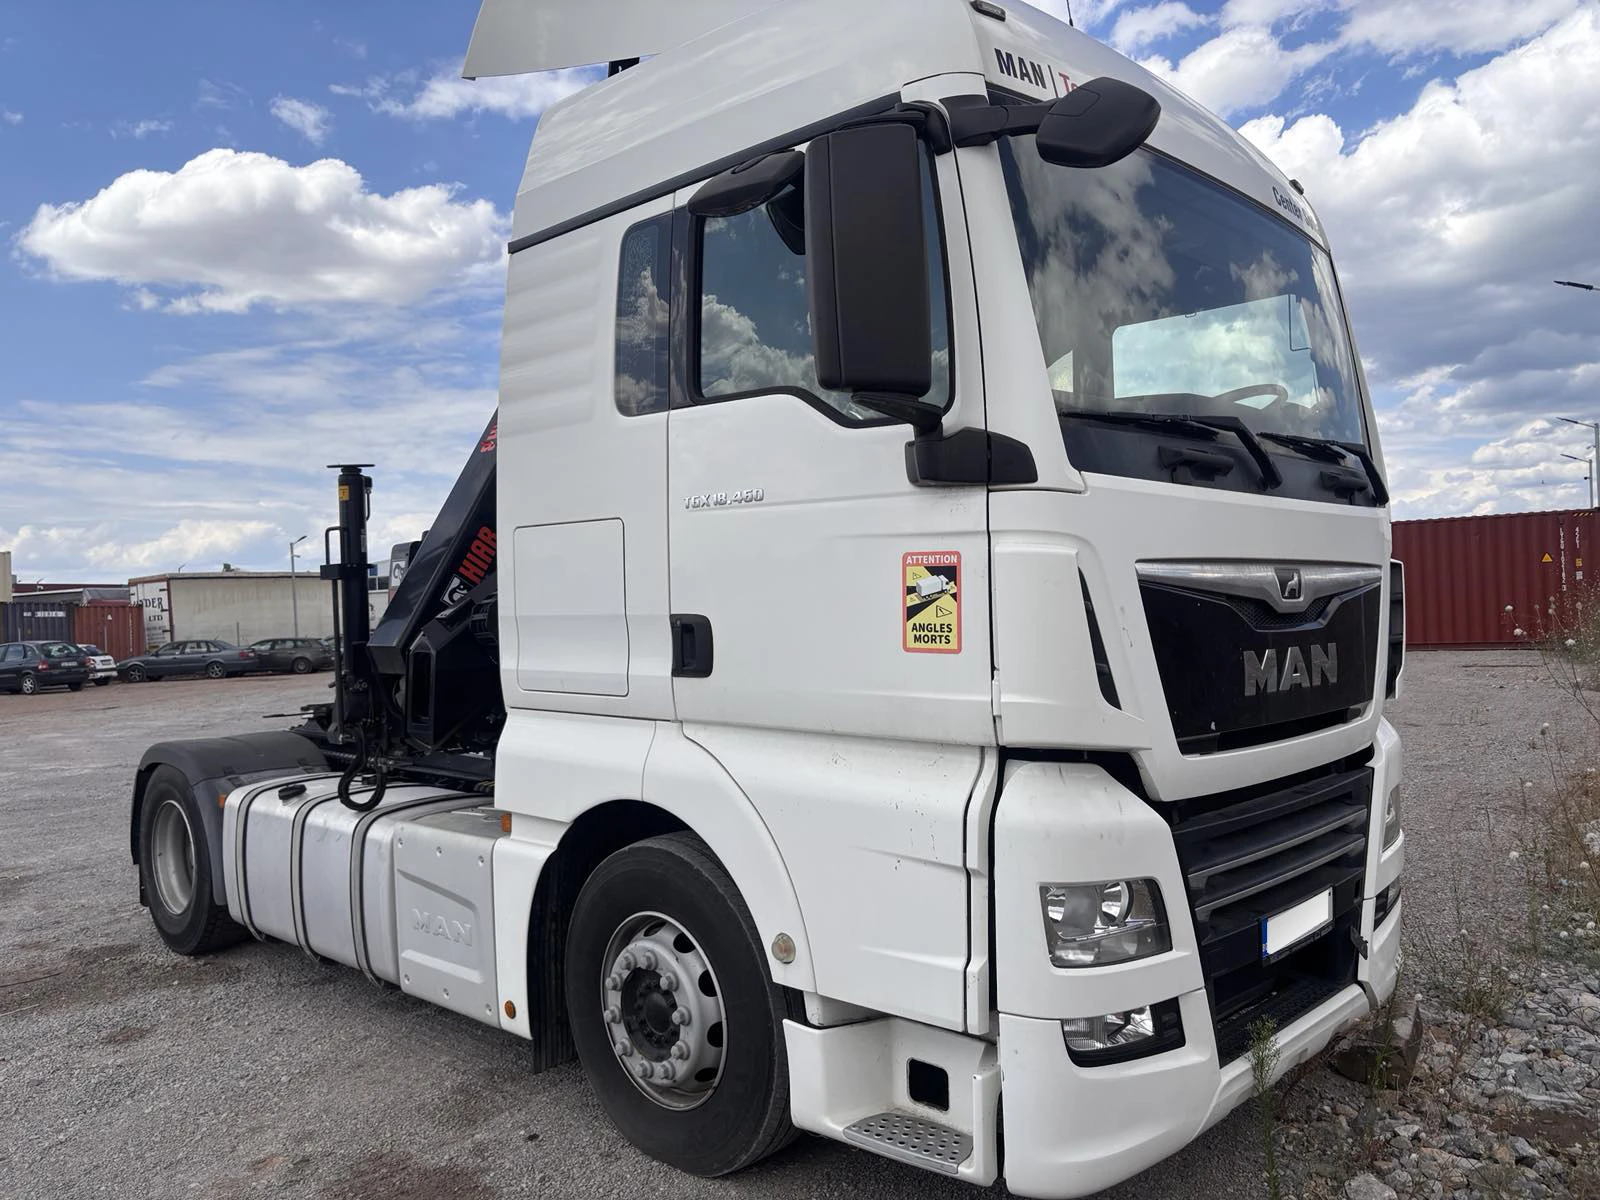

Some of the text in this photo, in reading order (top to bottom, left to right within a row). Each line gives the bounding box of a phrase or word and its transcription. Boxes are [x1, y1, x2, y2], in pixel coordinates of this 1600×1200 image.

[994, 48, 1047, 90] MAN
[683, 488, 764, 509] TGX 18.460
[906, 554, 958, 565] ATTENTION
[911, 622, 953, 634] ANGLES
[913, 634, 951, 645] MORTS
[1243, 642, 1338, 697] MAN
[412, 908, 473, 948] MAN
